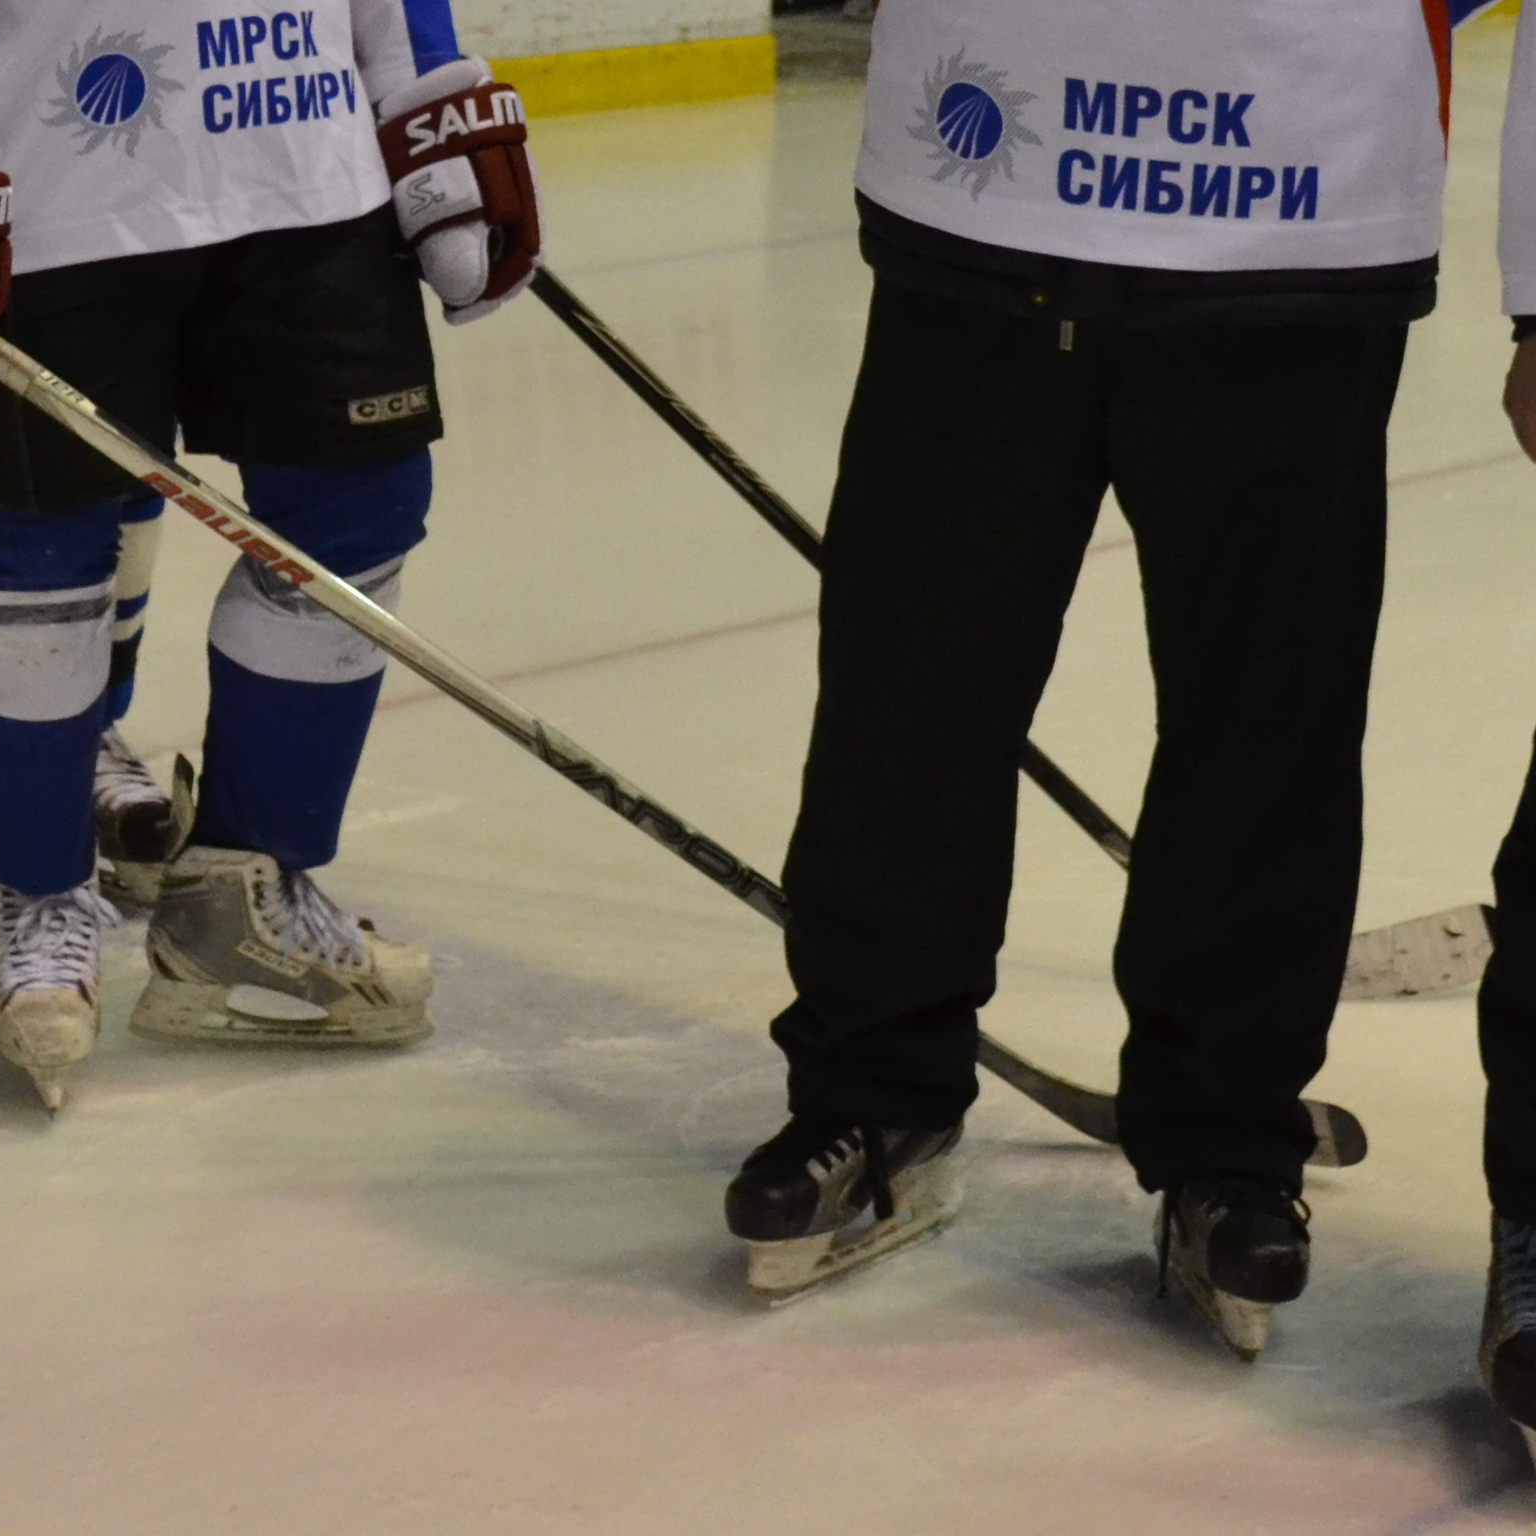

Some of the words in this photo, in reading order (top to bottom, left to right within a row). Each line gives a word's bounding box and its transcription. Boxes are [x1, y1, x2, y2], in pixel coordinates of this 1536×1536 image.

[197, 11, 318, 70] МРСК
[1063, 78, 1259, 149] МРСК
[1057, 148, 1320, 222] СИБИРИ
